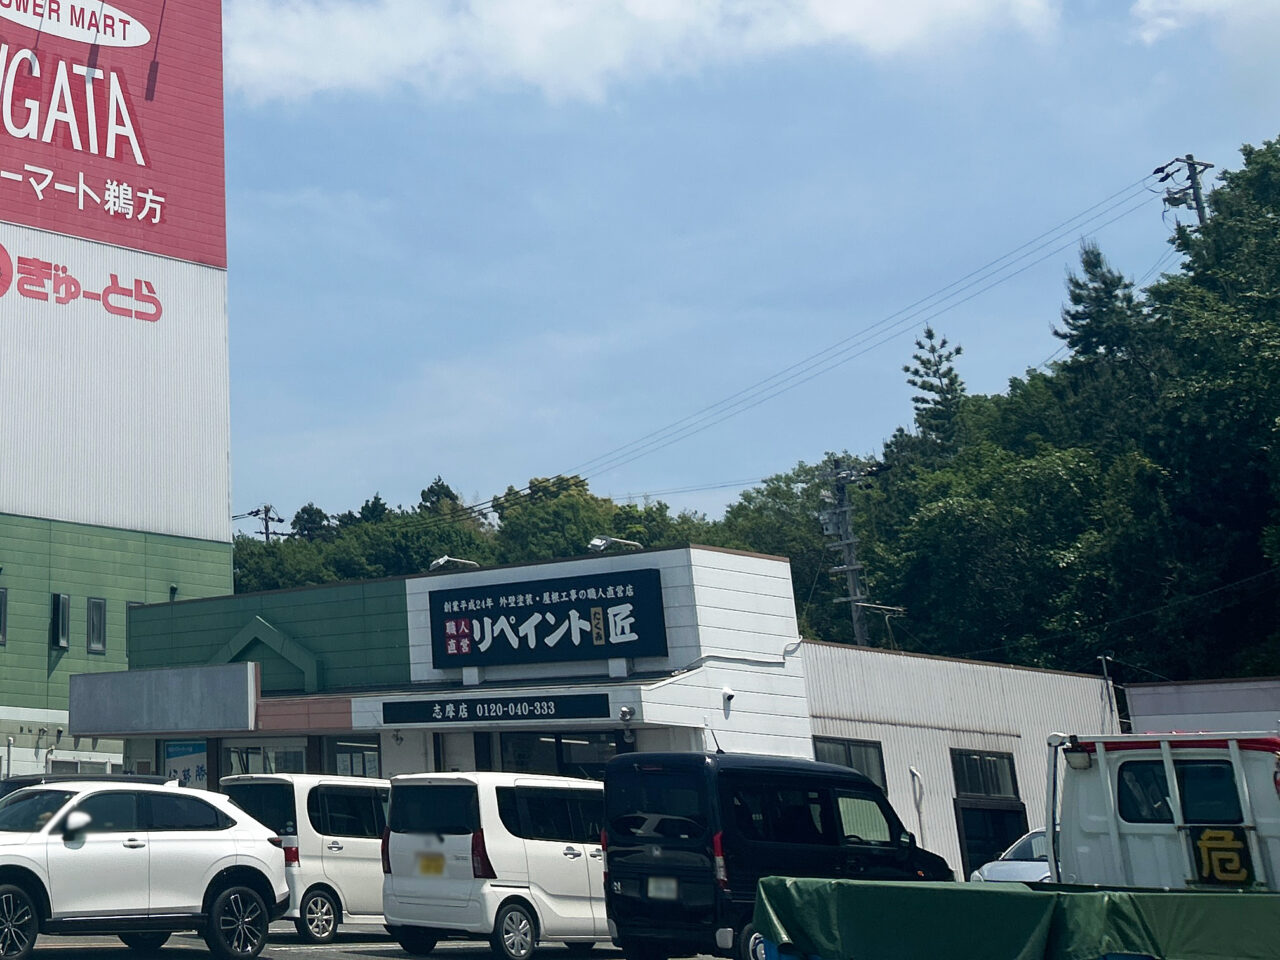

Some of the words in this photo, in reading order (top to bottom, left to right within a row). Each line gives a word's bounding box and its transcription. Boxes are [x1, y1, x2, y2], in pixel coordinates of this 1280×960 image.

[70, 7, 130, 41] MART
[16, 255, 163, 322] ぎゅーとら
[444, 598, 494, 613] 創業平成24年
[607, 603, 639, 644] 匠
[472, 609, 591, 652] リペイント
[432, 703, 468, 719] 志摩店
[476, 701, 556, 717] 0120-040-333
[1197, 829, 1248, 881] 危
